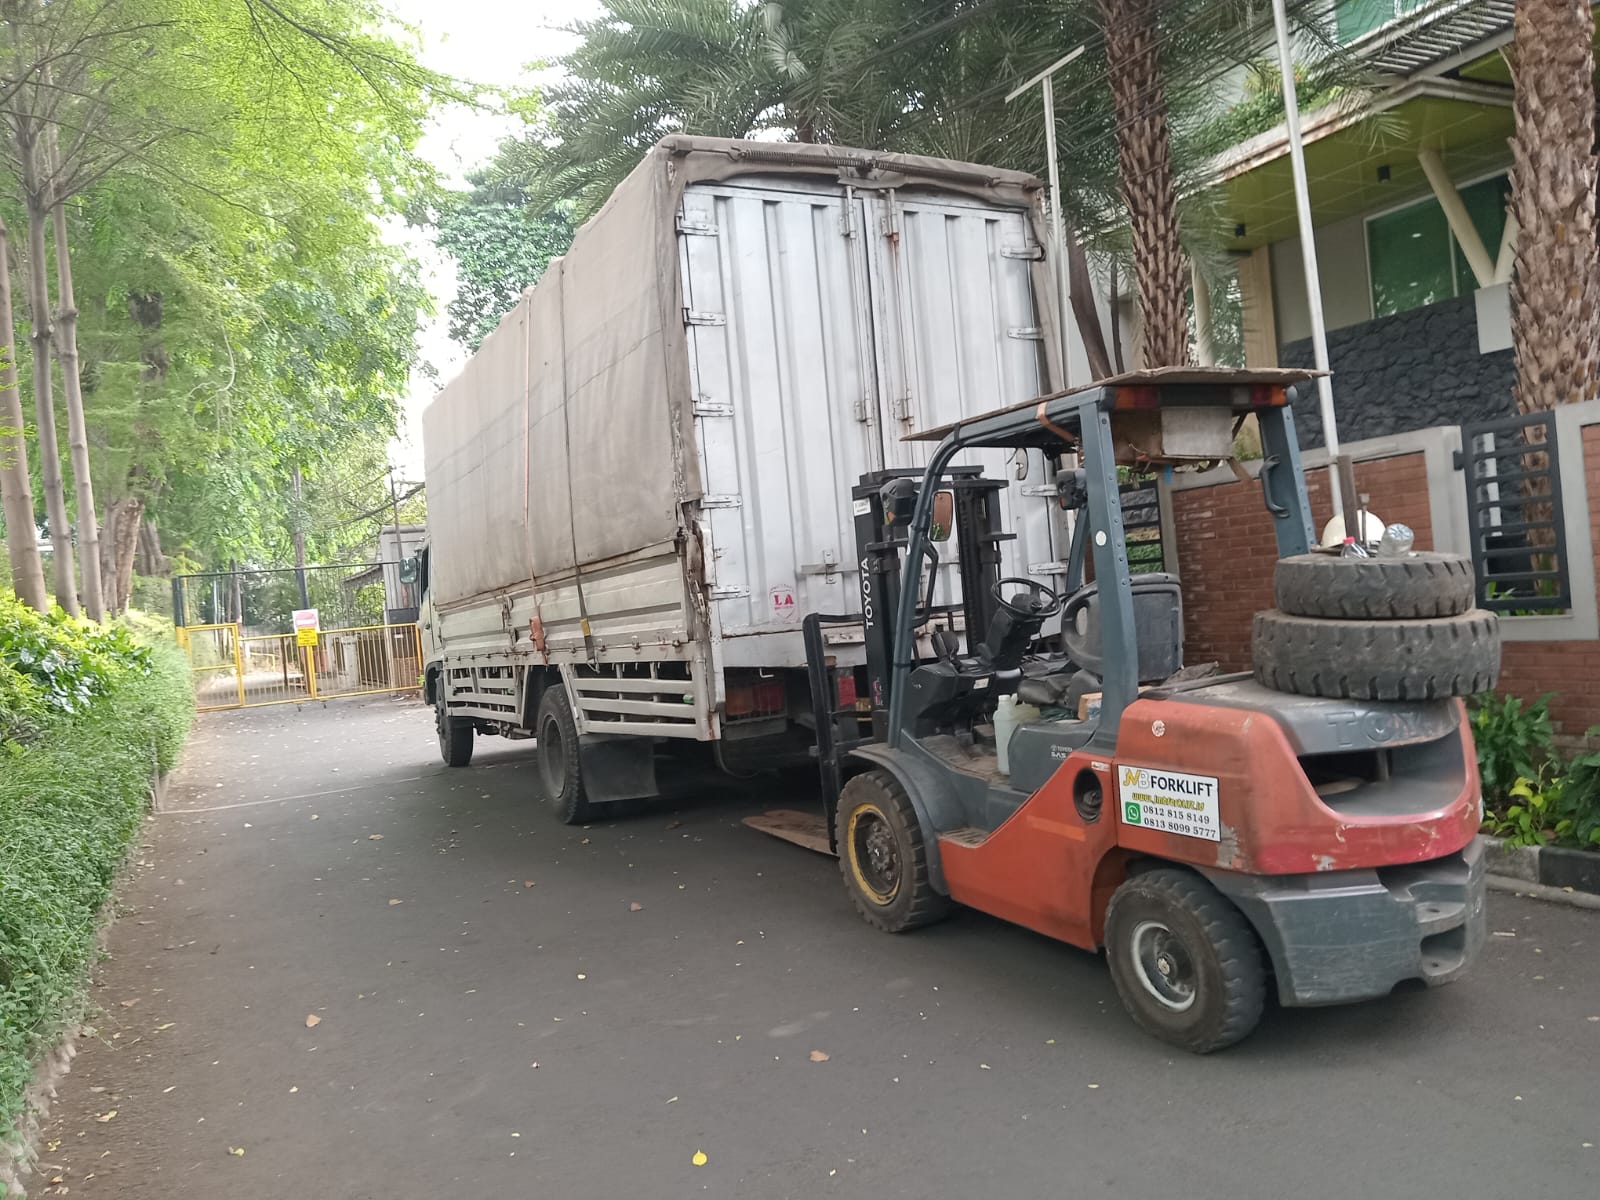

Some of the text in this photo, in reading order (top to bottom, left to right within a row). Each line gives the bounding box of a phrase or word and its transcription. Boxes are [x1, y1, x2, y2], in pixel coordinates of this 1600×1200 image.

[861, 557, 875, 630] TOYOTA
[1151, 775, 1213, 797] FORKLIFT
[1143, 805, 1210, 825] 0812 815 8149
[1144, 817, 1216, 838] 0813 8099 5777
